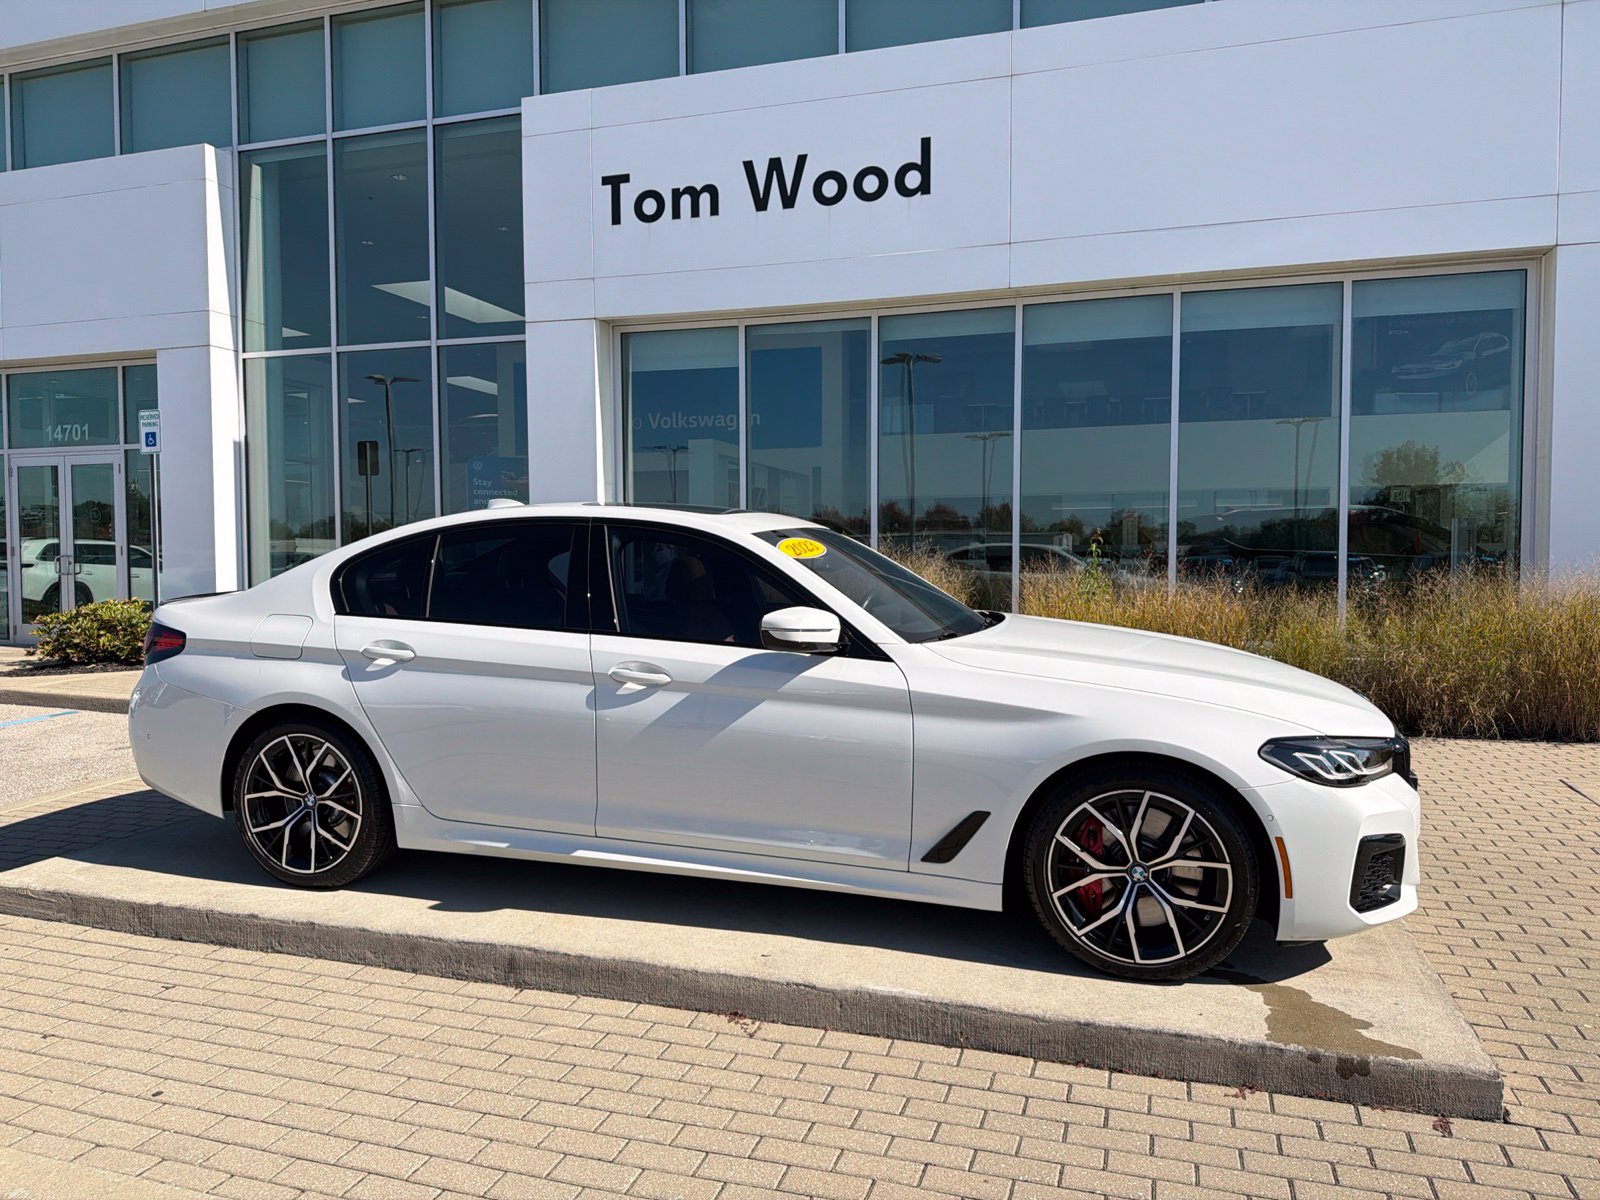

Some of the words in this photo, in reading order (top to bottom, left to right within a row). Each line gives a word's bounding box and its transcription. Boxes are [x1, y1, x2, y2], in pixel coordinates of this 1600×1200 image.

[601, 173, 719, 226] Tom
[742, 136, 932, 212] Wood
[648, 411, 760, 431] Volkswagn
[46, 423, 89, 441] 14701
[473, 478, 492, 487] Stay
